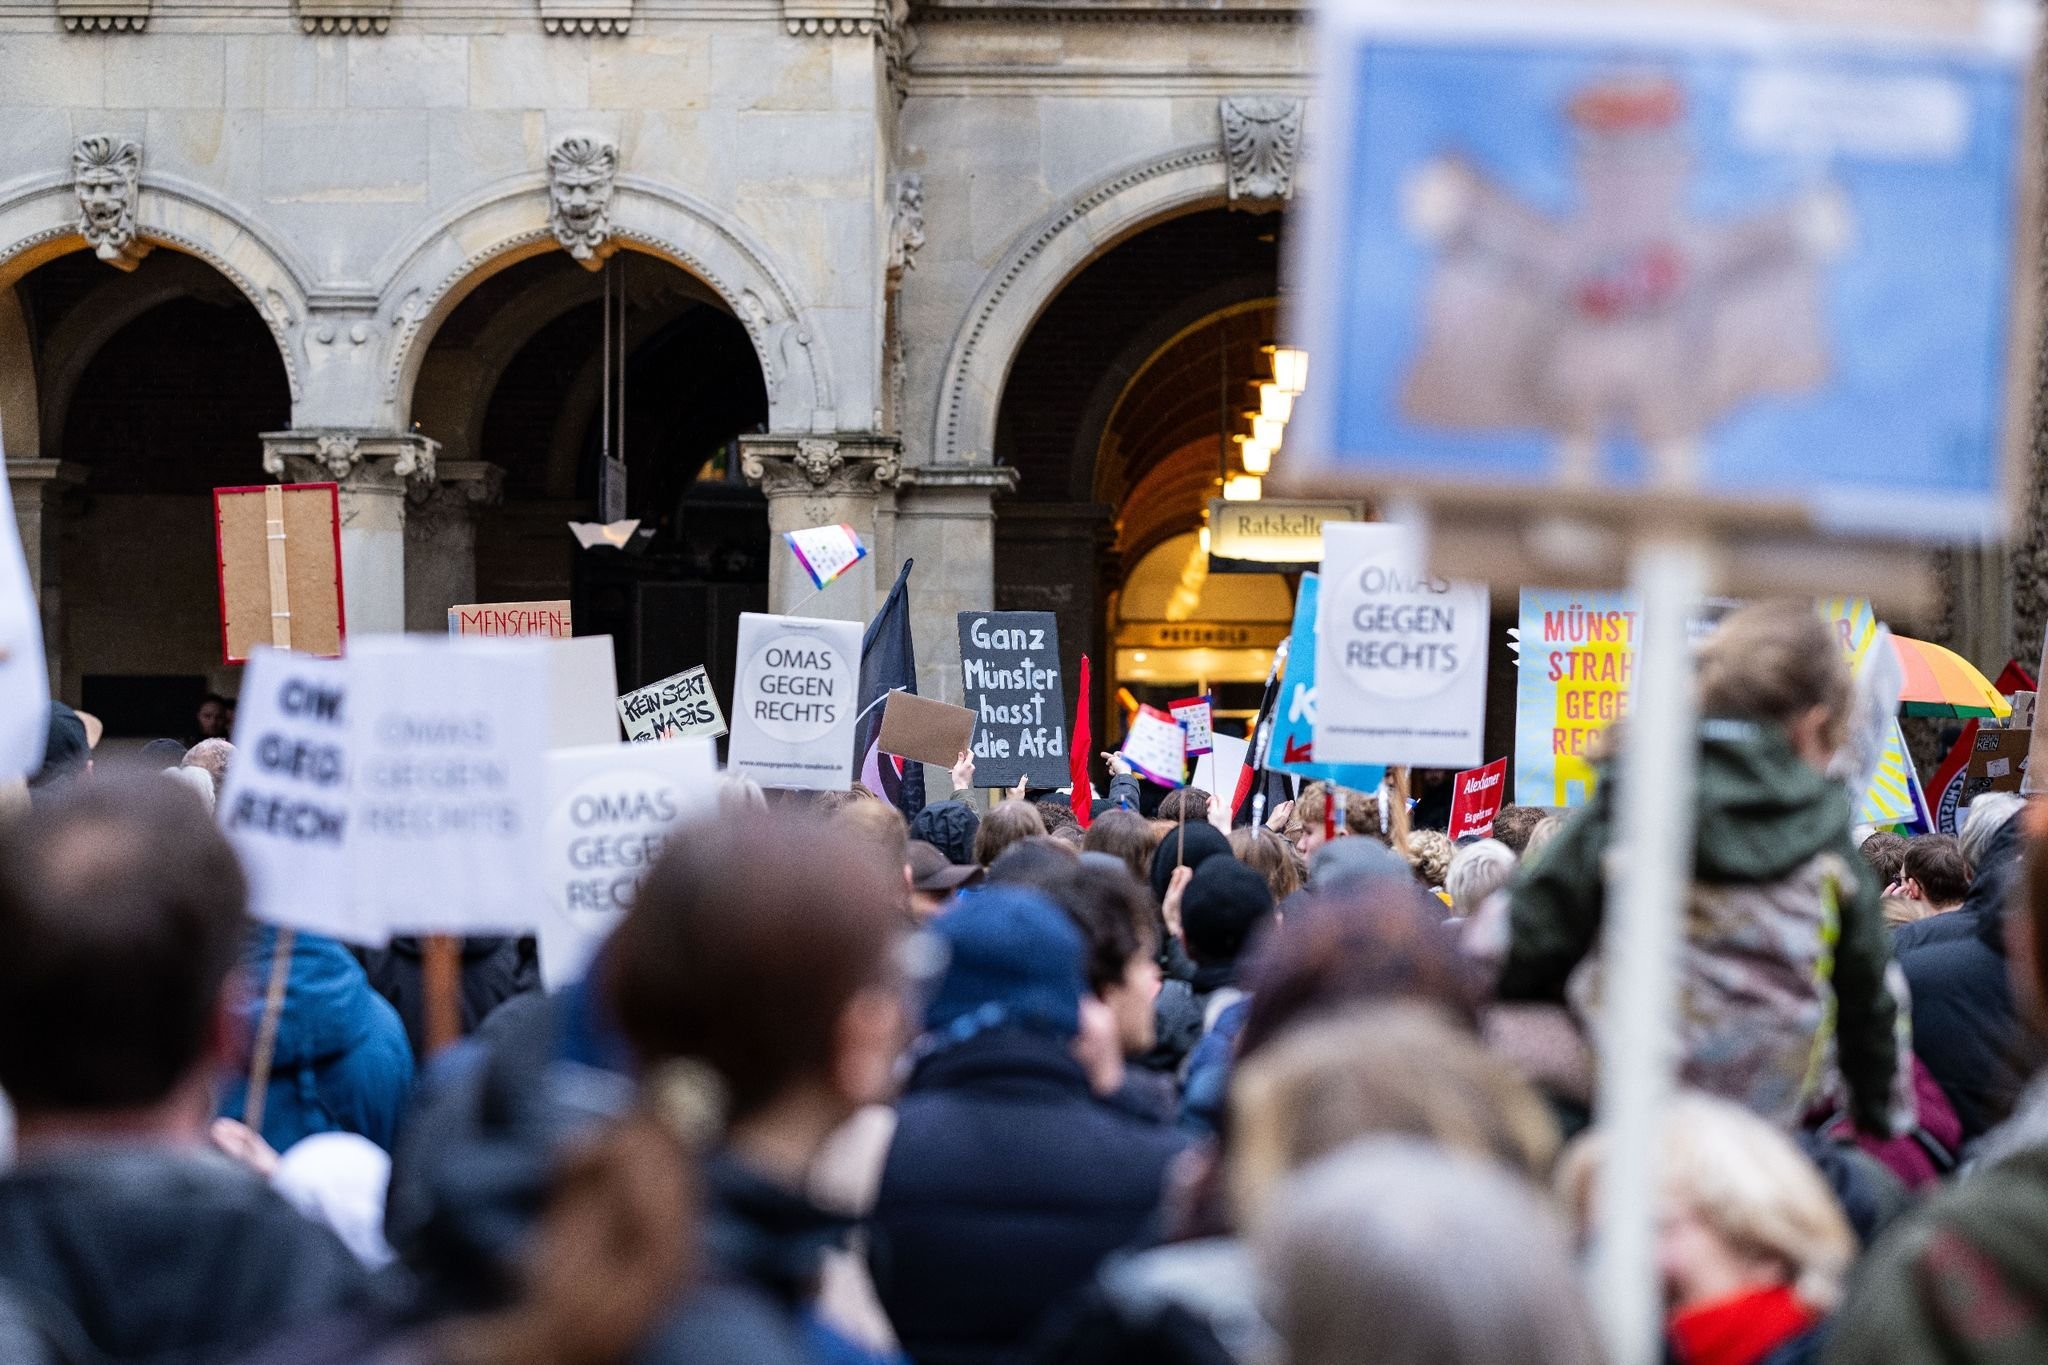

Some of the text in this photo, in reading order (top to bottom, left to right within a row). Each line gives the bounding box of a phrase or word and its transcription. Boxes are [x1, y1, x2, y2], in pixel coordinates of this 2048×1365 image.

[461, 610, 571, 638] MENSCHEN-
[971, 617, 1045, 650] Ganz
[1353, 603, 1455, 633] GEGEN
[765, 648, 832, 671] OMAS
[1346, 640, 1458, 672] RECHTS
[662, 673, 705, 706] SEKT
[760, 674, 833, 697] GEGEN
[964, 657, 1058, 690] Münster
[754, 701, 836, 723] RECHTS
[979, 692, 1045, 725] hasst
[973, 726, 1063, 758] die Afd
[570, 787, 677, 829] OMAS
